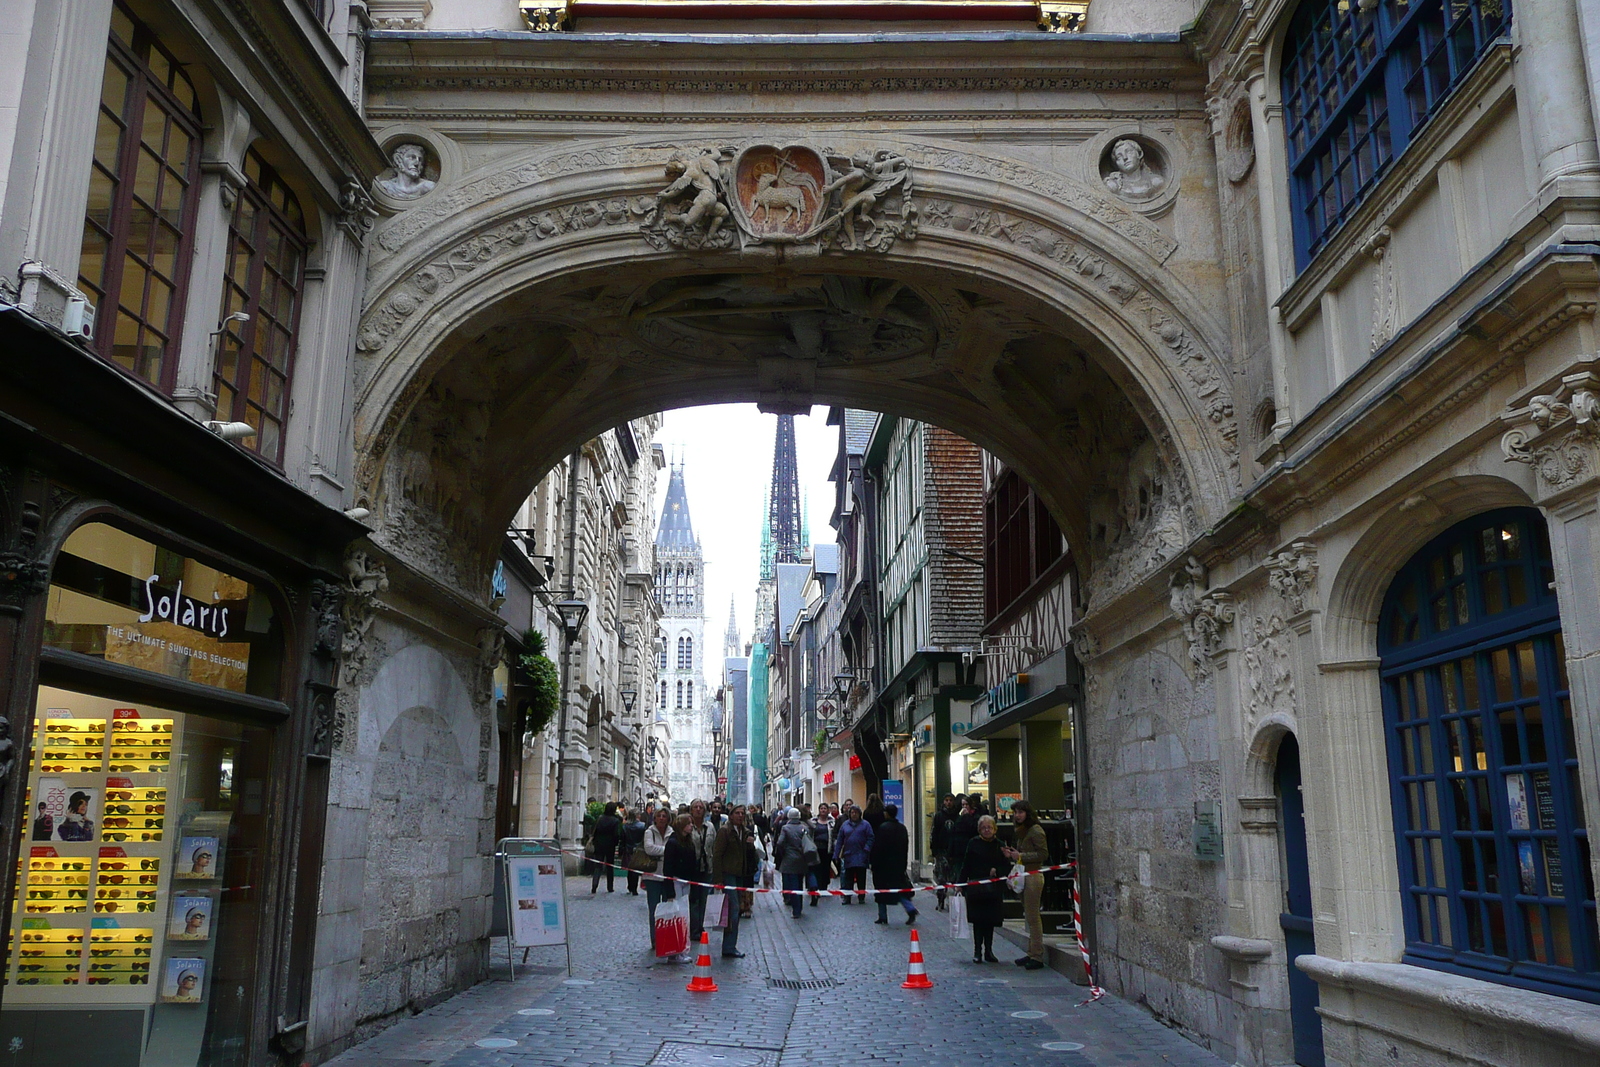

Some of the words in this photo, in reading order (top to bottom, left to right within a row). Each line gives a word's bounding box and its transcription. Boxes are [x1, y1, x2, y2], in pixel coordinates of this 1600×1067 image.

[139, 574, 228, 637] Solaris
[107, 625, 124, 638] THE
[127, 631, 166, 649] ULTIMATE
[168, 642, 208, 660] SUNGLASS
[210, 653, 246, 670] SELECTION
[43, 787, 57, 832] LONDON
[54, 787, 66, 817] LOOK
[190, 838, 218, 848] Solaris
[184, 899, 210, 908] Solaris
[176, 960, 203, 969] Solaris
